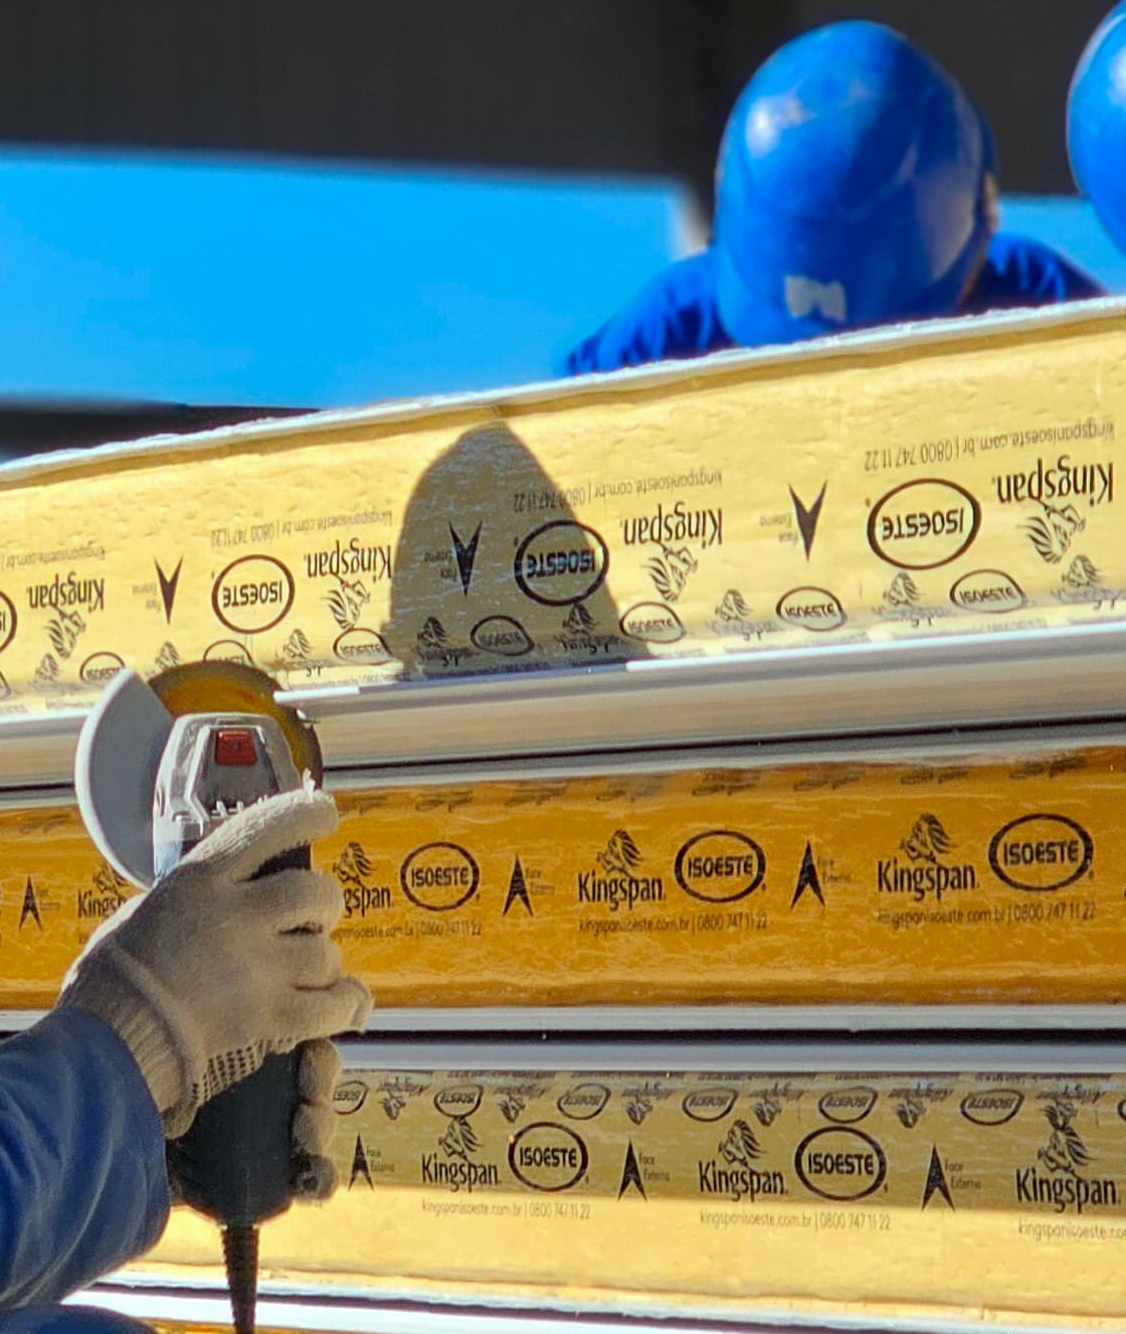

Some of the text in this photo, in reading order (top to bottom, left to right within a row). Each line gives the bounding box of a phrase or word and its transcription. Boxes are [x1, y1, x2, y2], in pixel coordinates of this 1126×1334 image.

[962, 419, 1115, 454] kingspanisoeste.com.br
[865, 449, 879, 470] 22
[895, 443, 917, 468] 747
[921, 438, 953, 462] 0800
[997, 455, 1113, 507] Kingspan
[514, 494, 525, 513] 22
[624, 501, 722, 549] Kingspan
[882, 508, 964, 541] ISOESTE
[307, 537, 392, 582] Kingspan
[527, 549, 596, 578] ISOESTE
[29, 571, 105, 613] Kingspan
[223, 582, 282, 608] ISOESTE
[959, 586, 1014, 606] ISOESTE
[784, 603, 835, 620] ISOESTE
[1004, 841, 1078, 865] ISOESTE
[411, 867, 468, 887] ISOESTE
[688, 856, 754, 878] ISOESTE
[877, 857, 975, 901] Kingspan
[78, 890, 128, 917] Kings
[344, 886, 390, 917] gspan
[578, 870, 663, 911] Kingspan
[520, 1147, 576, 1167] ISOESTE
[808, 1153, 874, 1176] ISOESTE
[422, 1153, 498, 1193] Kingspan
[1016, 1168, 1117, 1214] Kingspan
[529, 1202, 550, 1218] 0800
[553, 1204, 567, 1218] 747
[581, 1204, 590, 1219] 22
[819, 1213, 842, 1229] 0800
[848, 1213, 864, 1229] 747
[879, 1214, 890, 1229] 22
